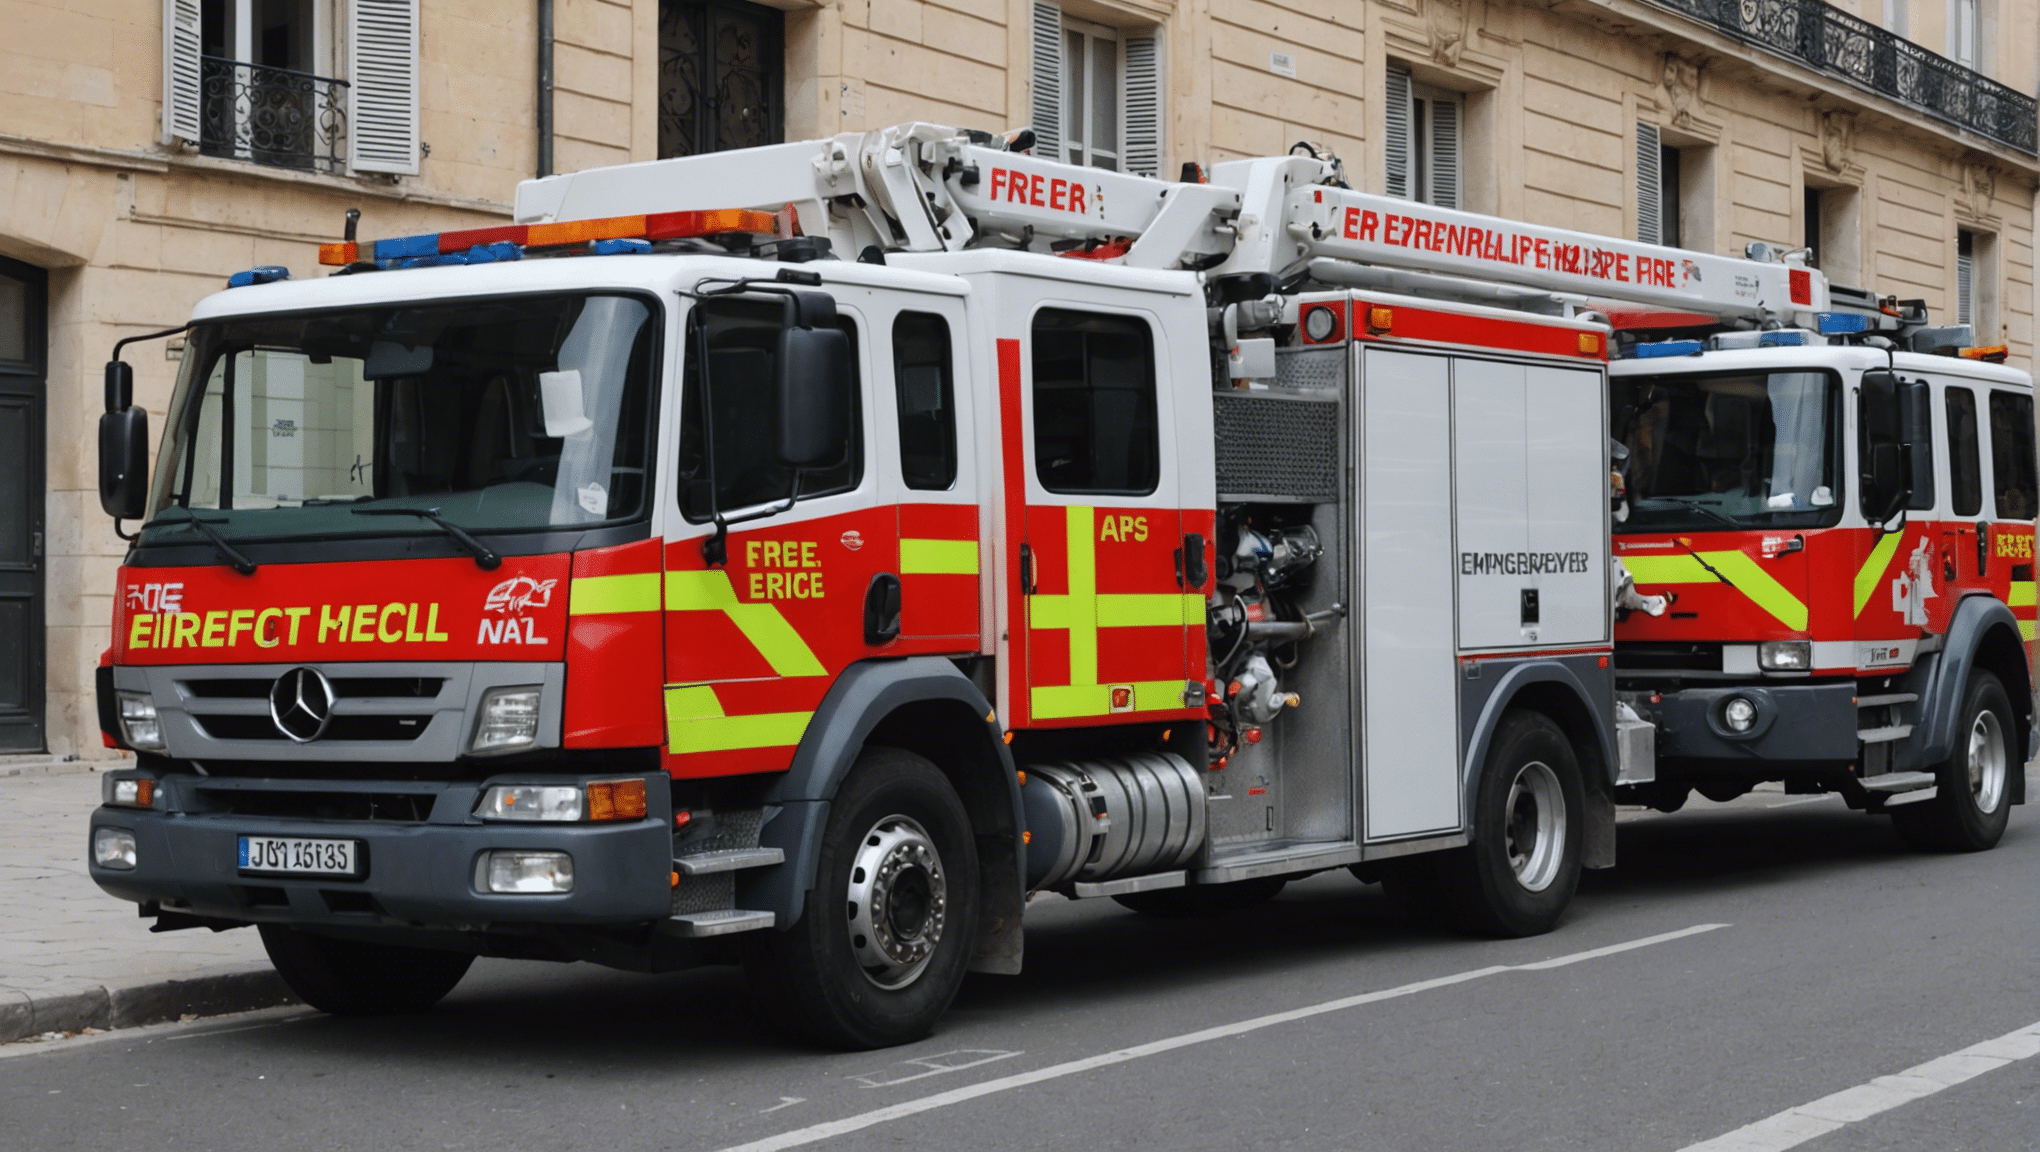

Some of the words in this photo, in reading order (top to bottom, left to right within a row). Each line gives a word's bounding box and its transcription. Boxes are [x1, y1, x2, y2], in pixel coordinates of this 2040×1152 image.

[990, 167, 1086, 215] FREER
[1344, 206, 1379, 242] ER
[1100, 514, 1148, 543] APS
[749, 572, 825, 599] ERICE
